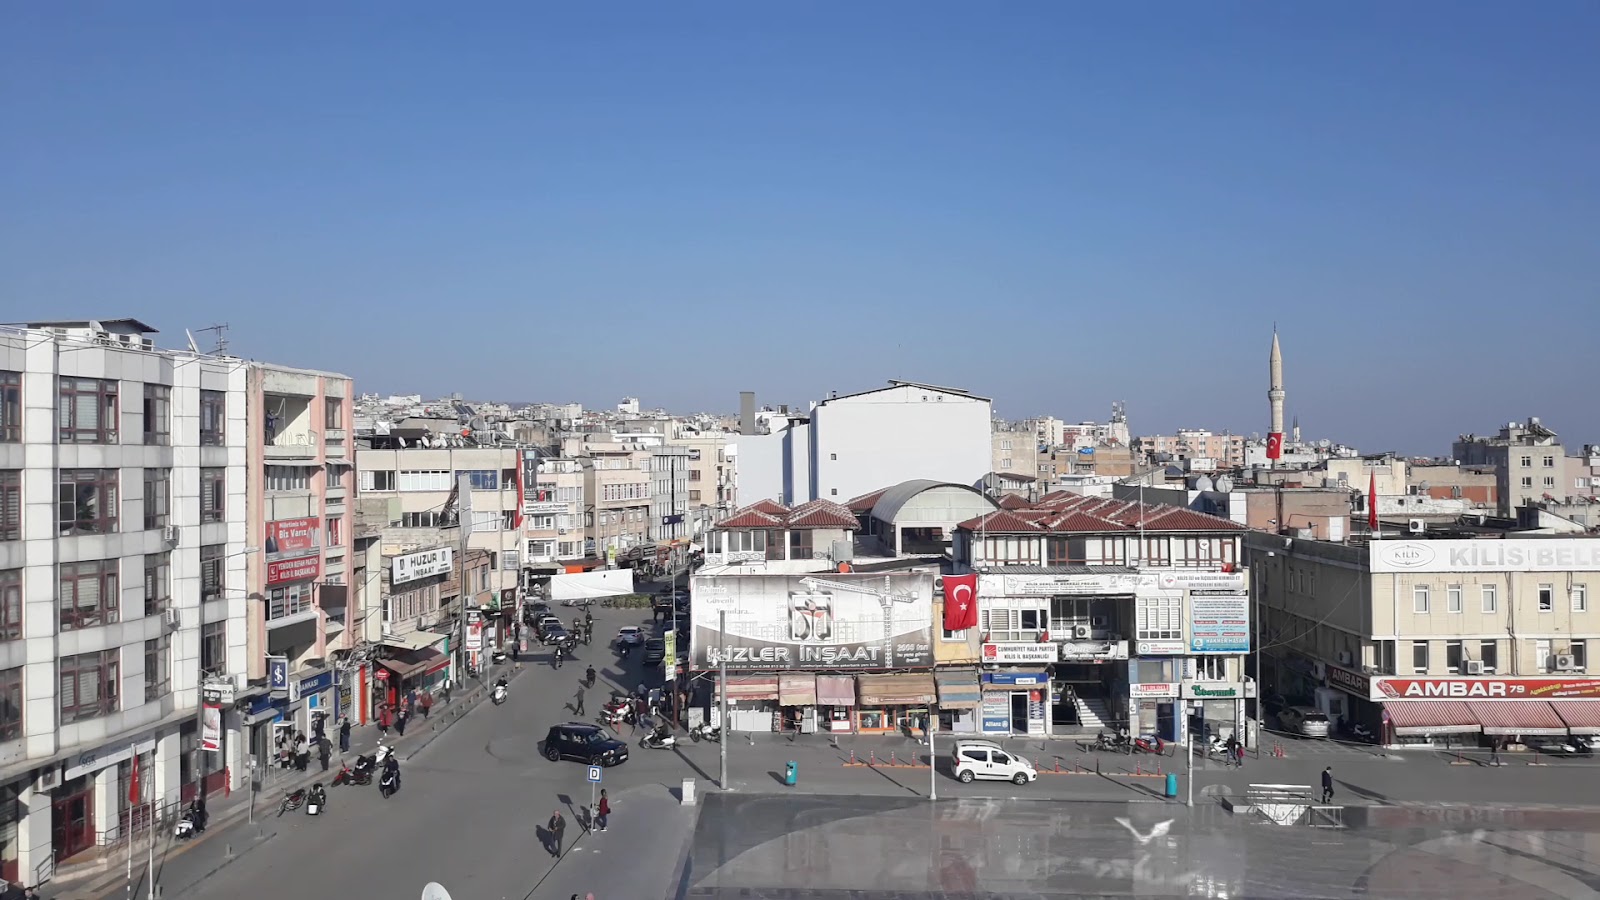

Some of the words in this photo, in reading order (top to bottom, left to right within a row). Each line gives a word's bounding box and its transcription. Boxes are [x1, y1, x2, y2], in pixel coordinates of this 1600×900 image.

[279, 530, 289, 539] Biz
[410, 553, 437, 567] HUZUR
[1394, 550, 1420, 559] KİLİS
[1450, 543, 1524, 566] KİLİS
[799, 643, 881, 665] İNŞAAT
[1022, 653, 1050, 661] BAŞKANLIĞI
[1332, 669, 1362, 689] AMBAR
[1404, 682, 1506, 697] AMBAR
[1509, 685, 1525, 693] 79
[592, 769, 598, 778] D
